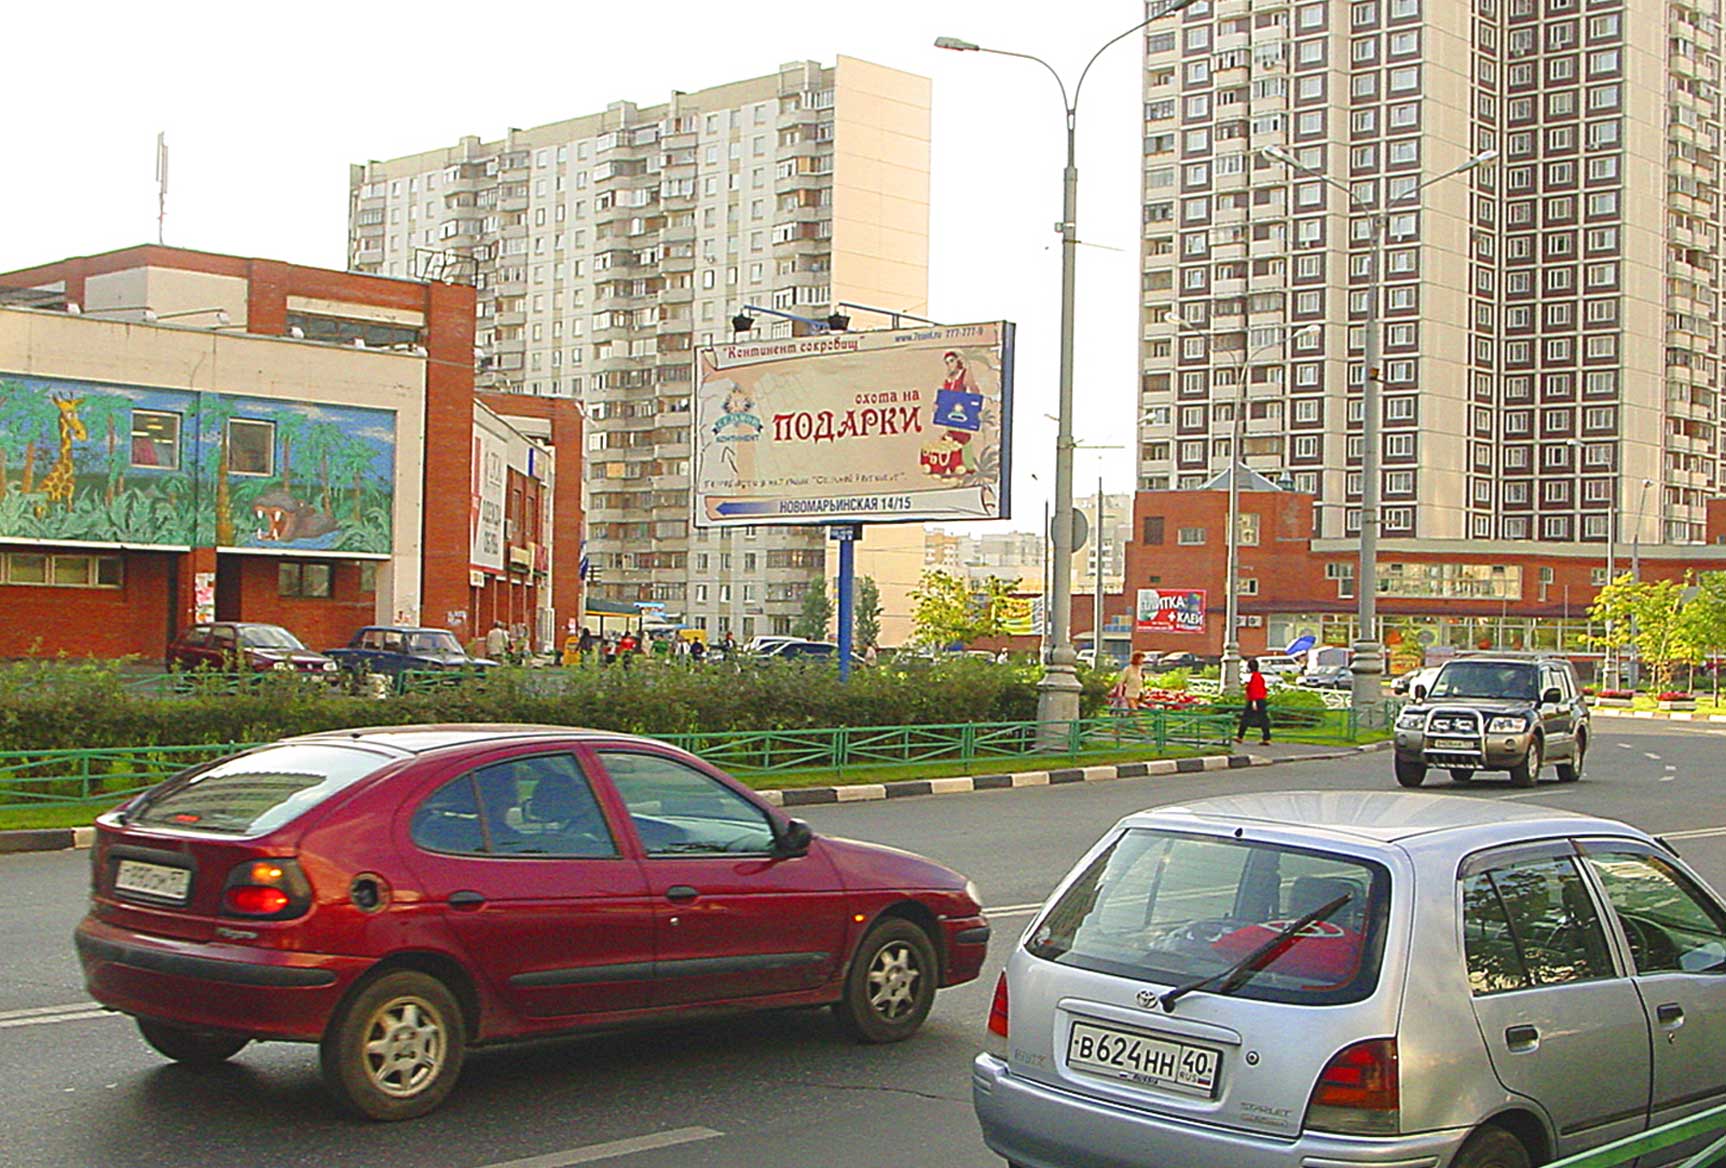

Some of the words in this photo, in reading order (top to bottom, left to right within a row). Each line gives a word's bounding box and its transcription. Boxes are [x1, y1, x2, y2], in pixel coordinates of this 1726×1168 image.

[855, 391, 897, 404] охота
[903, 390, 920, 402] на
[772, 406, 922, 444] ПОДАРКИ
[779, 497, 878, 514] НОВОМАРЬИНСКАЯ
[882, 496, 911, 510] 14/15
